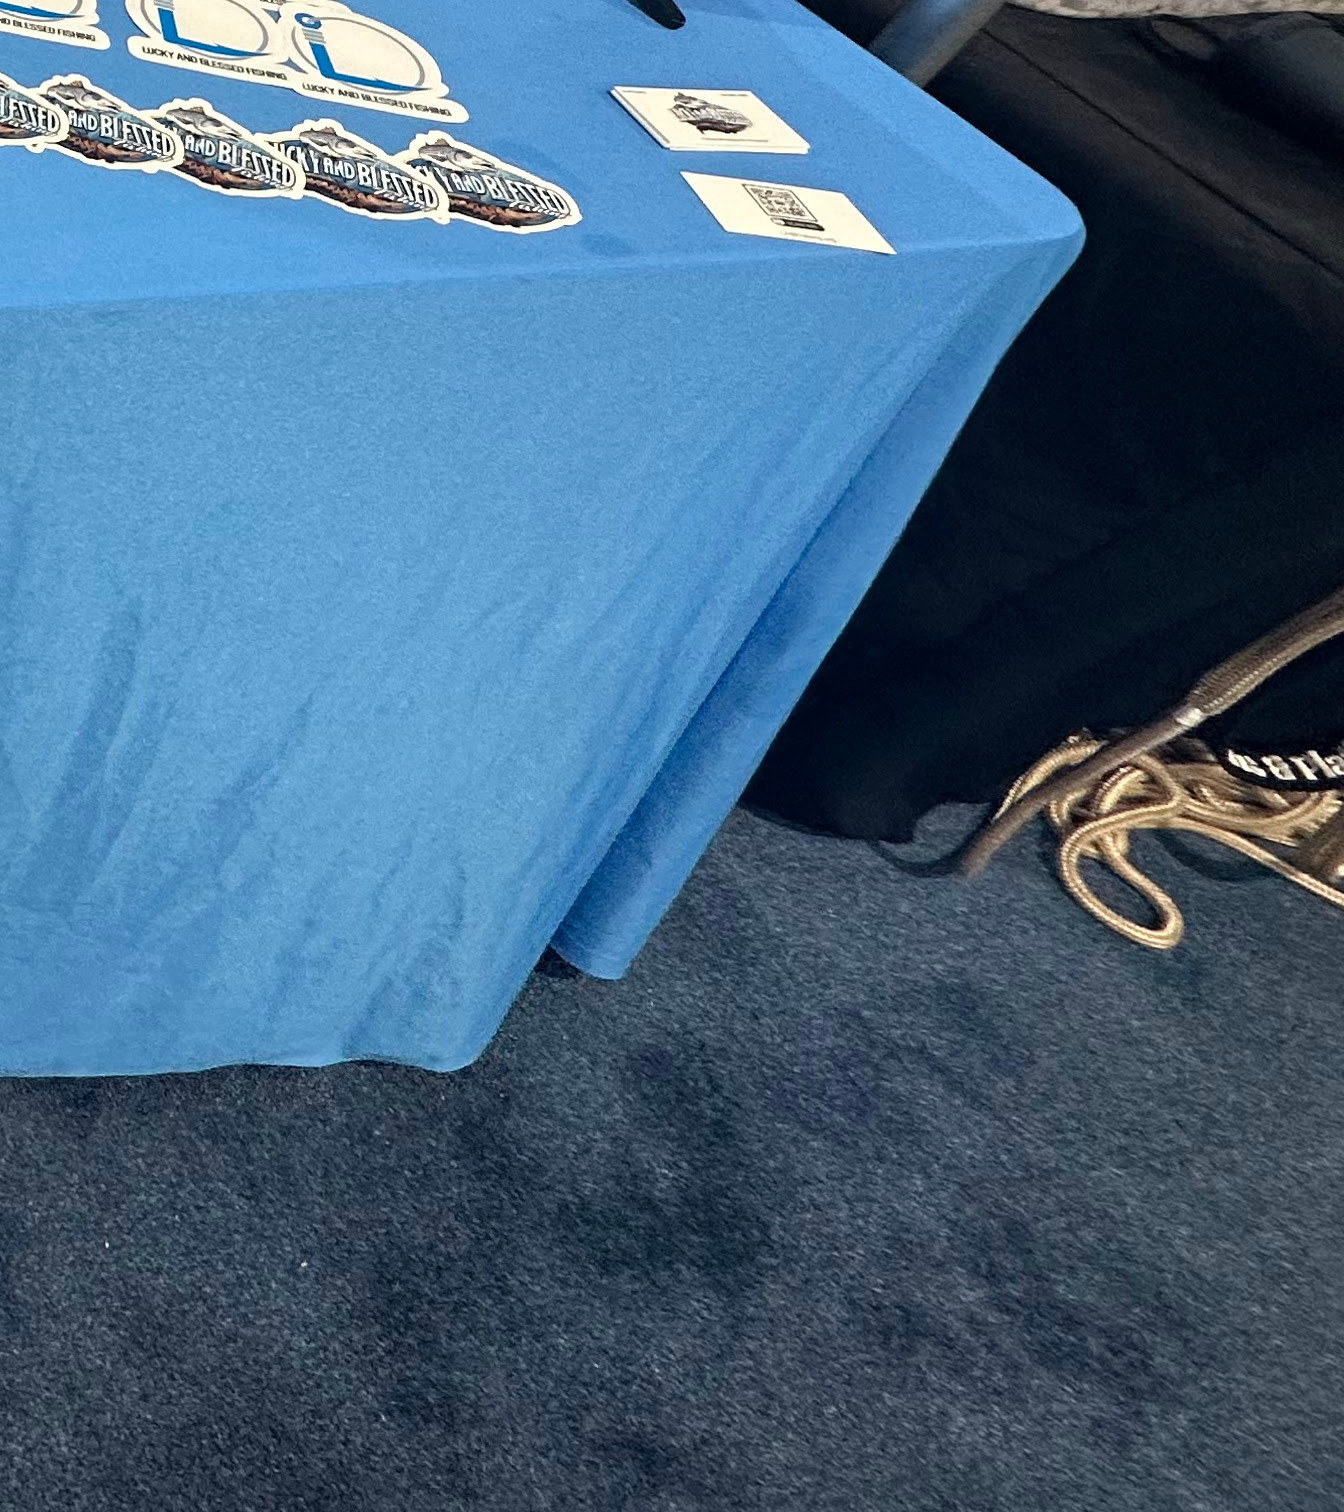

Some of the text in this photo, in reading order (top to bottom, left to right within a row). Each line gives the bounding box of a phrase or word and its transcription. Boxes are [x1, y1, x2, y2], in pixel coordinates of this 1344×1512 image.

[142, 46, 287, 81] LUCKY AND BLESSED FISHING
